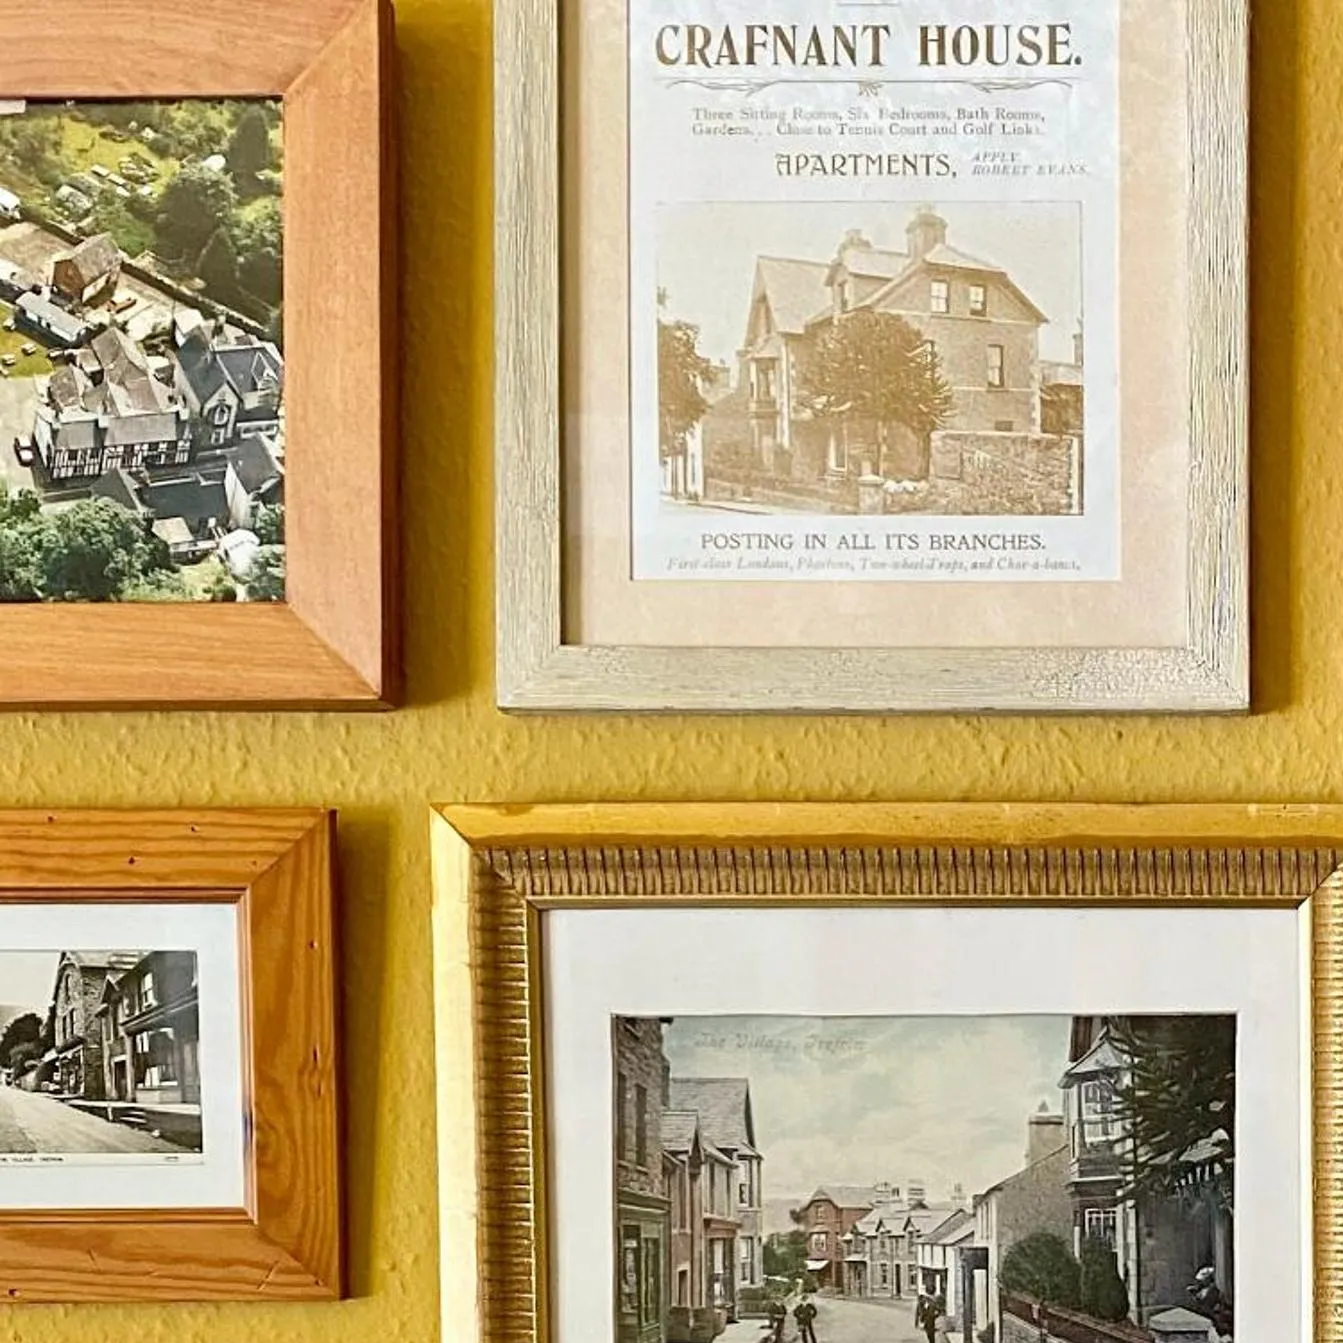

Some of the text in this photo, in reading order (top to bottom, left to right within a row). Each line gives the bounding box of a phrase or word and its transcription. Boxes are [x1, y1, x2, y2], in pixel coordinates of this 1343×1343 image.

[655, 23, 1083, 68] CRAFNANT HOUSE.
[693, 108, 733, 121] Three
[957, 107, 989, 121] Bath
[818, 124, 831, 135] to
[889, 123, 927, 136] Court
[932, 123, 957, 136] and
[963, 123, 993, 136] Golf
[775, 153, 957, 178] APARTMENTS,
[701, 533, 1046, 550] POSTING IN ALL ITS BRANCHES.
